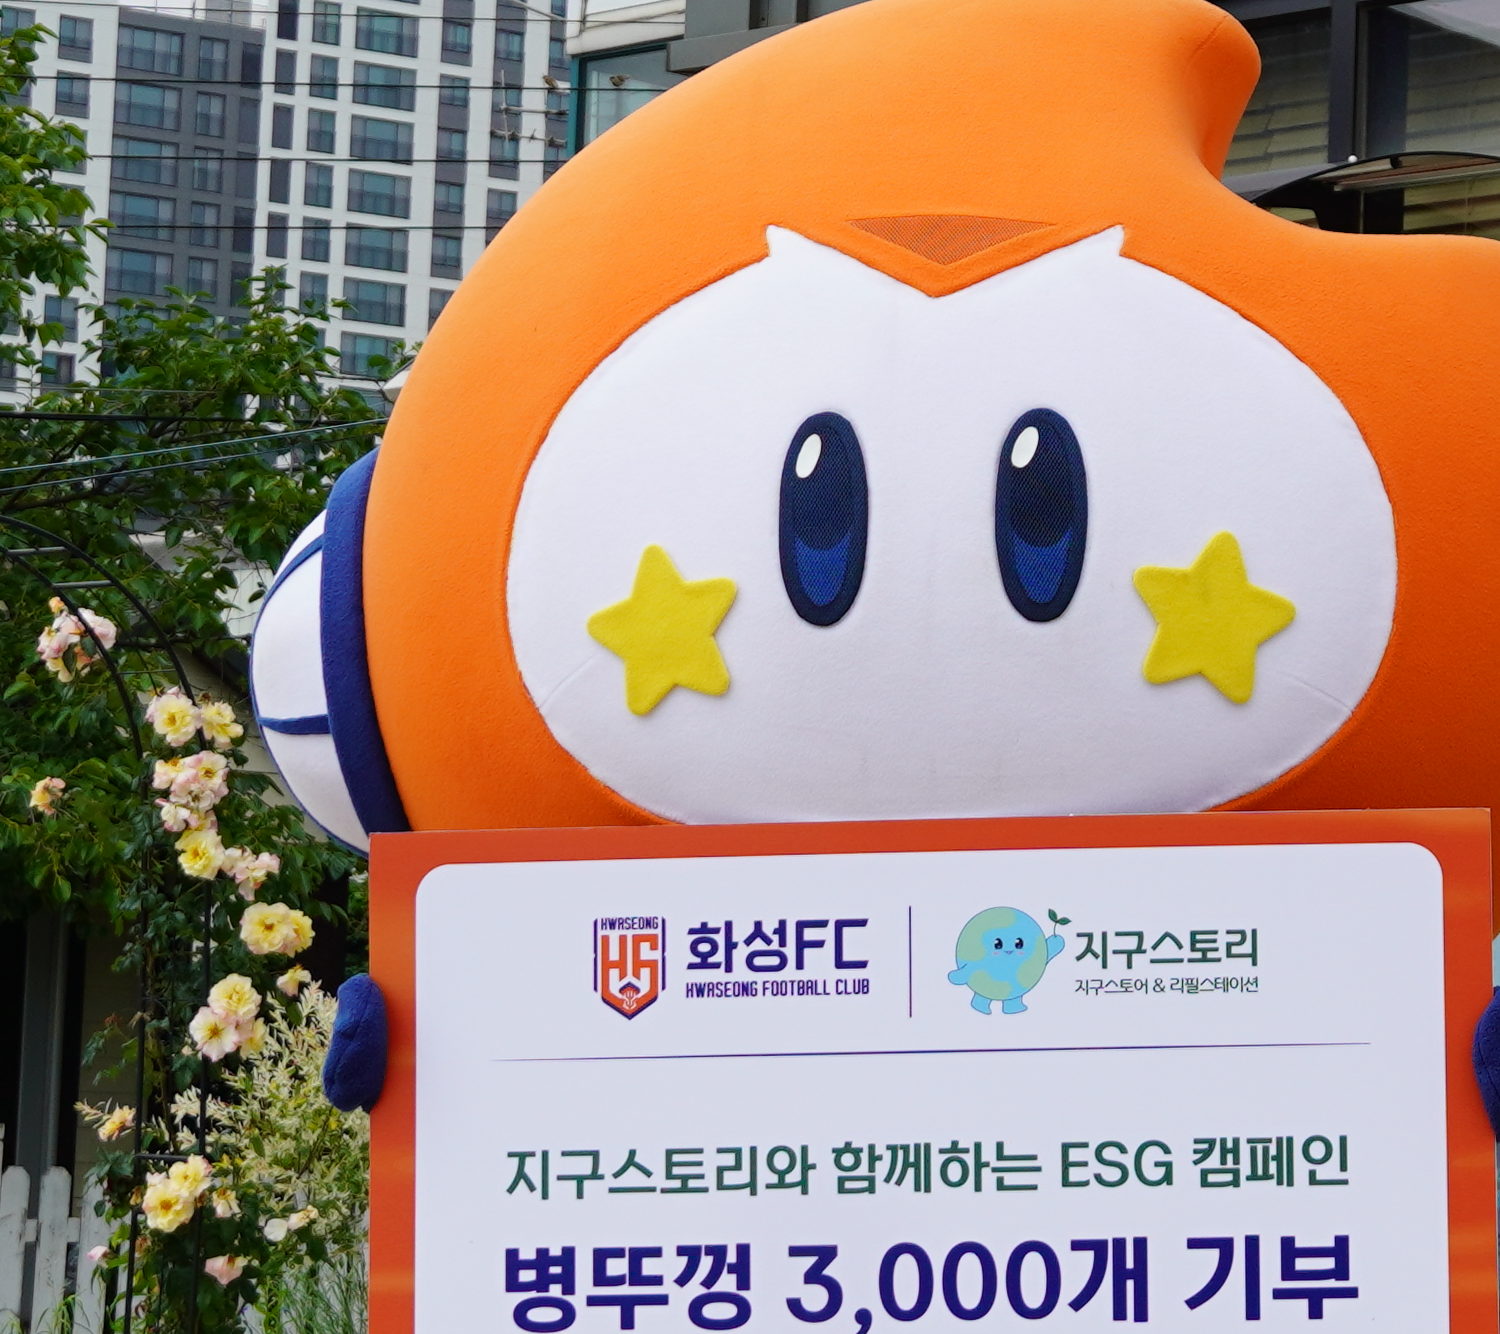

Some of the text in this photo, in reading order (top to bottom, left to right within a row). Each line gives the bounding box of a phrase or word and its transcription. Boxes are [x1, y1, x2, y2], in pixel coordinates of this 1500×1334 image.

[686, 919, 869, 973] 화성FC
[1075, 928, 1258, 970] 지구스토리
[686, 978, 870, 998] HWASEONG FOOTBALL CLUB
[1074, 976, 1259, 996] 지구스토어 & 리필스테이션
[506, 1133, 1351, 1201] 지구스토리와 함께하는 ESG 캠페인
[505, 1242, 754, 1334] 병뚜껑
[1184, 1233, 1361, 1322] 기부
